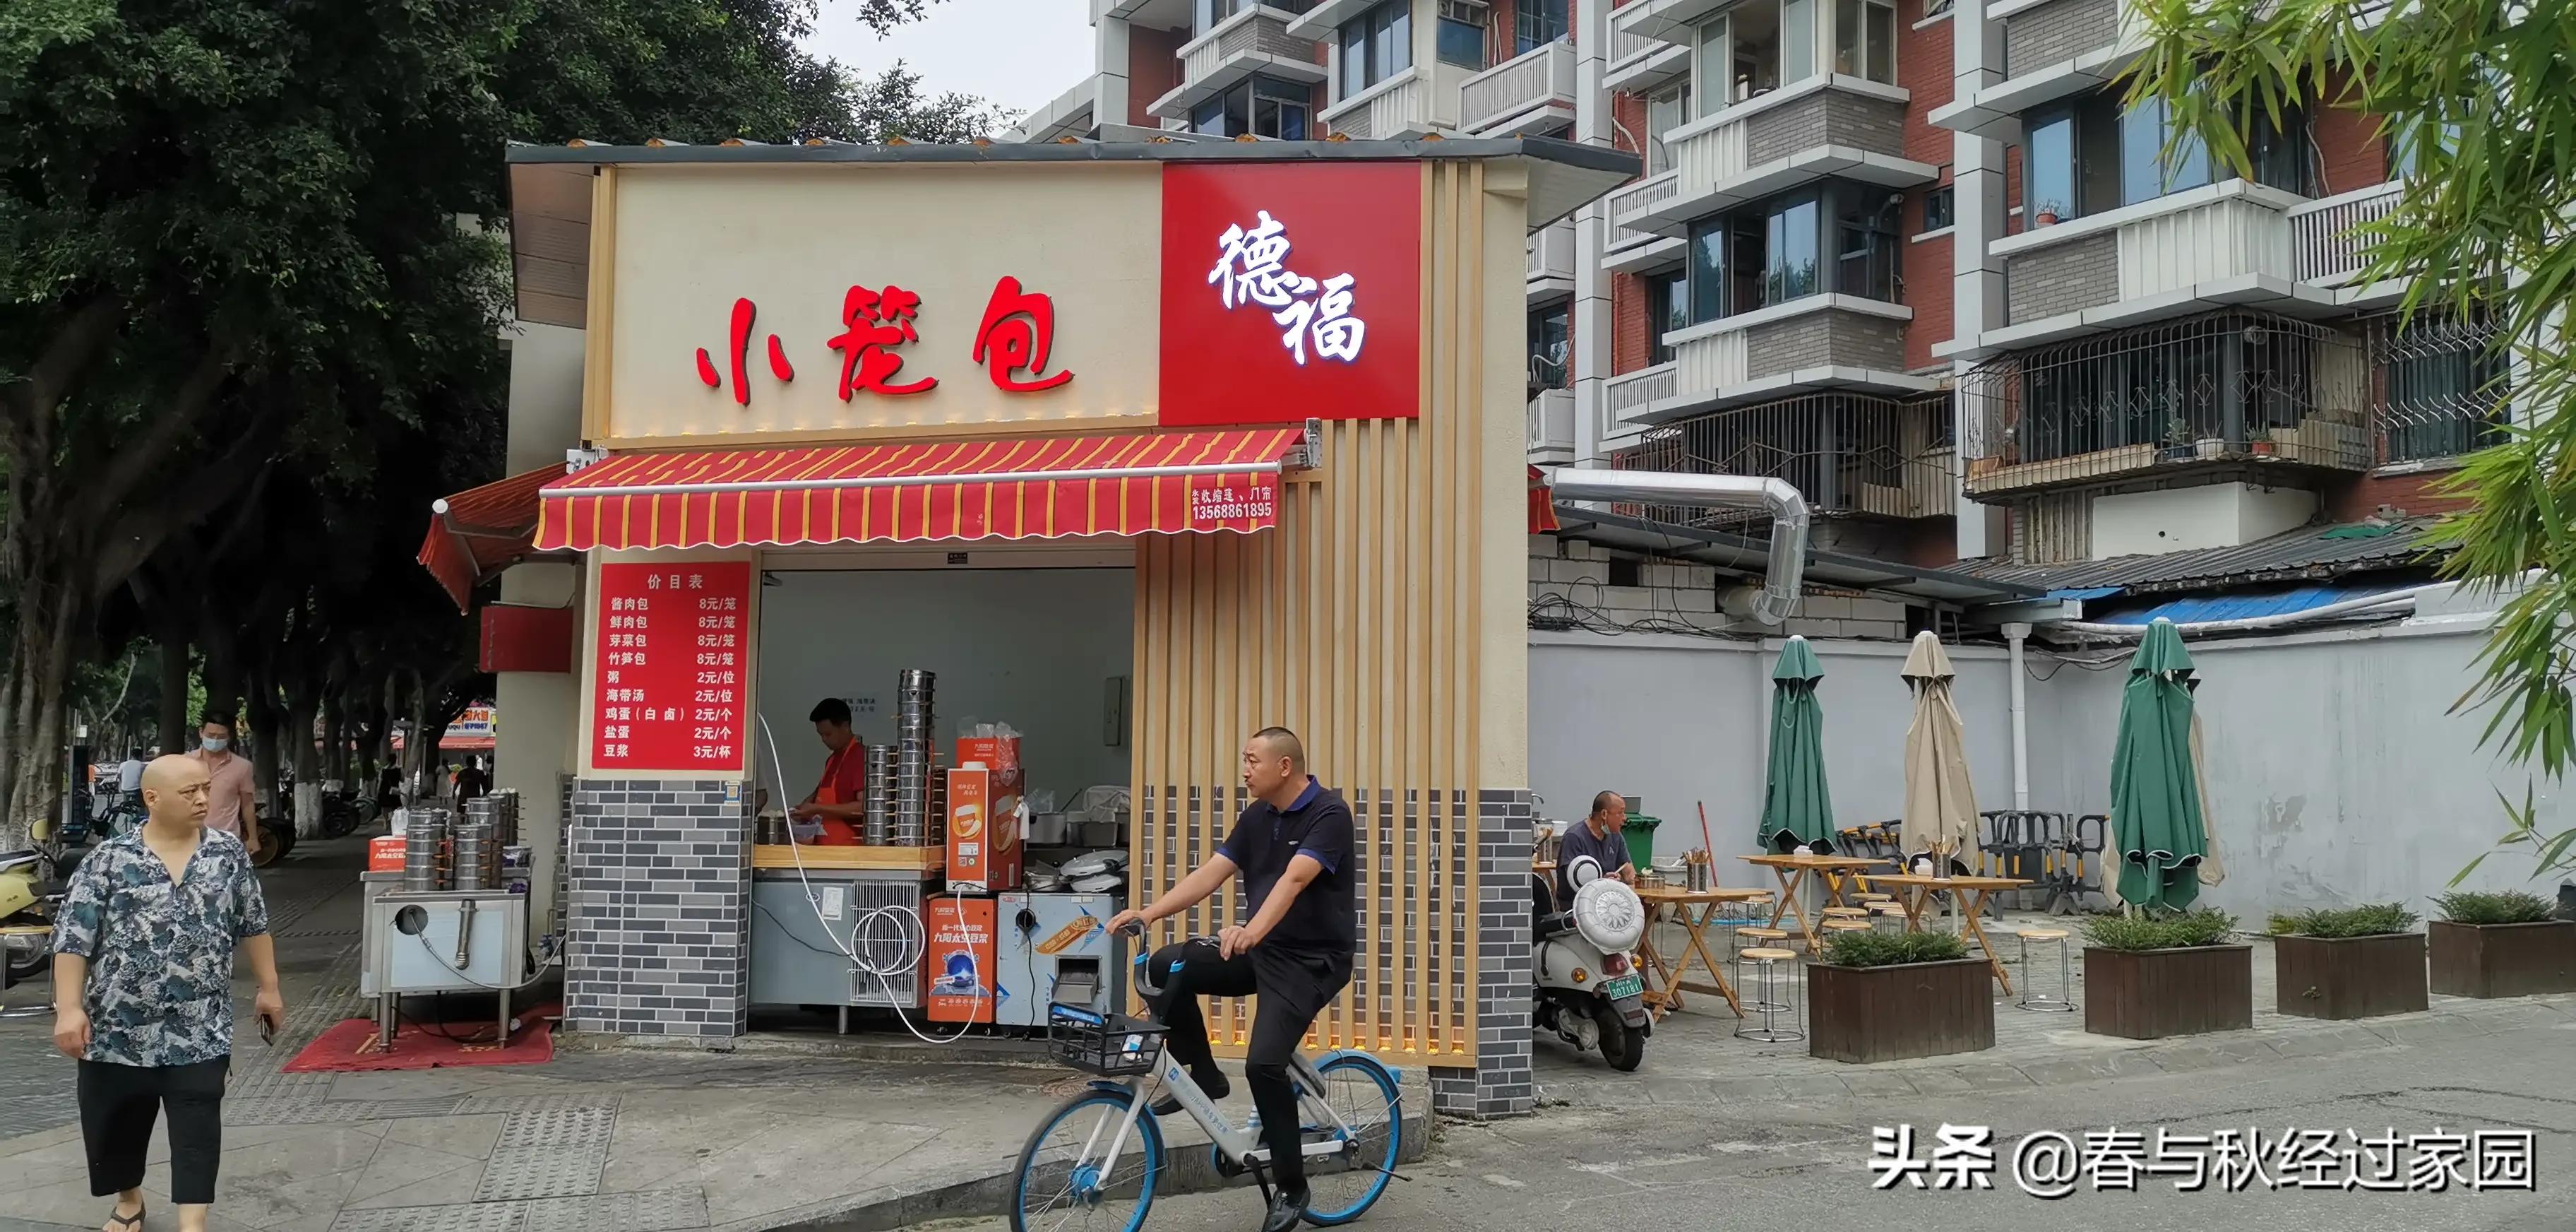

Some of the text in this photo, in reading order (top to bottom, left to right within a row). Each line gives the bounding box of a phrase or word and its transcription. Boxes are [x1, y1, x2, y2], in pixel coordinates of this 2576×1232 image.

[1208, 209, 1365, 365] 德福
[696, 276, 1073, 405] 小笼包
[1193, 502, 1272, 520] 13568861895
[648, 574, 703, 589] 价目表
[699, 598, 737, 611] 8元/笼
[610, 615, 736, 629] 鲜肉包 8元/笼
[697, 634, 735, 647] 8元/笼
[608, 651, 734, 665] 竹笋包 8元/笼
[607, 670, 735, 685] 粥 2元/位
[606, 688, 733, 703] 海带汤 2元/位
[695, 708, 733, 722] 2元/个
[604, 725, 732, 740] 盐蛋 2元/个
[604, 744, 732, 759] 豆浆 3元/杯
